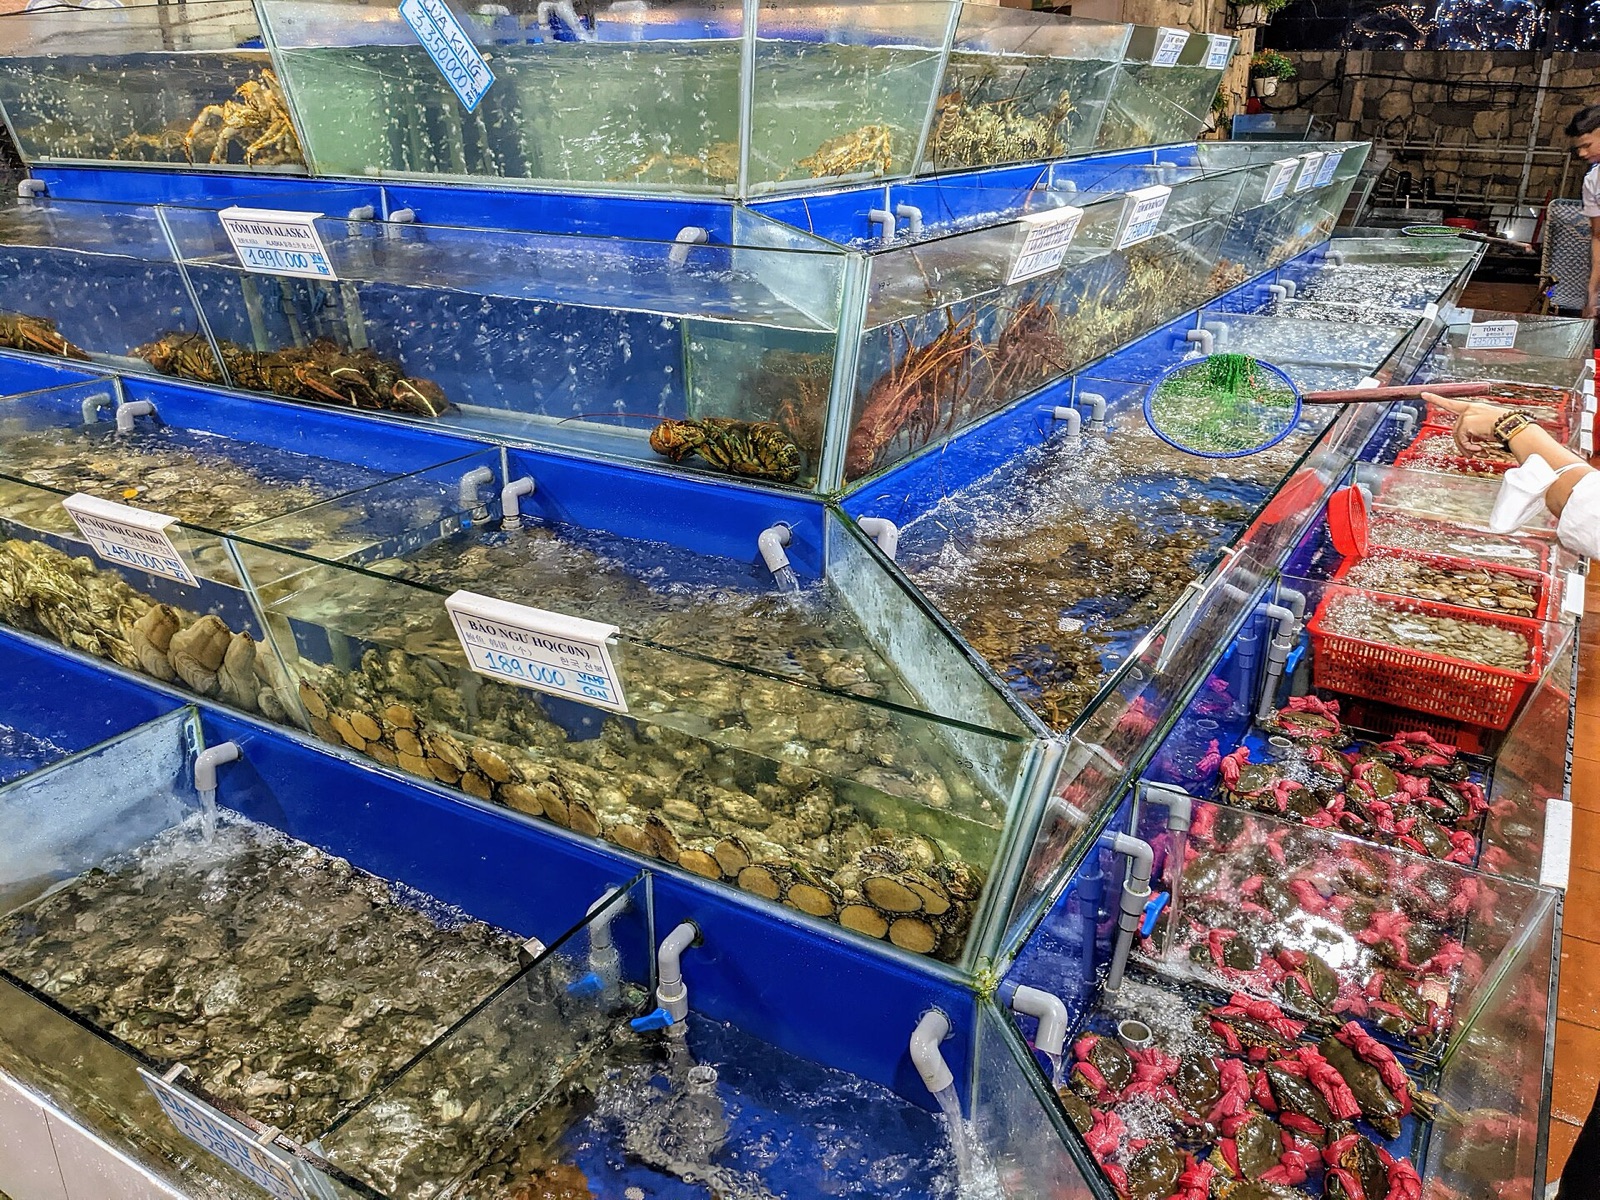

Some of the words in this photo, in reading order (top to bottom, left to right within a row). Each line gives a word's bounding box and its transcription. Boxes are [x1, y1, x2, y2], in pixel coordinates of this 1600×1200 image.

[450, 32, 482, 78] KING
[229, 221, 251, 234] TÔM
[274, 226, 311, 239] ALASKA
[125, 529, 167, 546] CANADA
[498, 628, 529, 643] NGƯ
[485, 650, 566, 687] 189.000
[560, 656, 580, 669] 한국
[582, 686, 609, 700] CON
